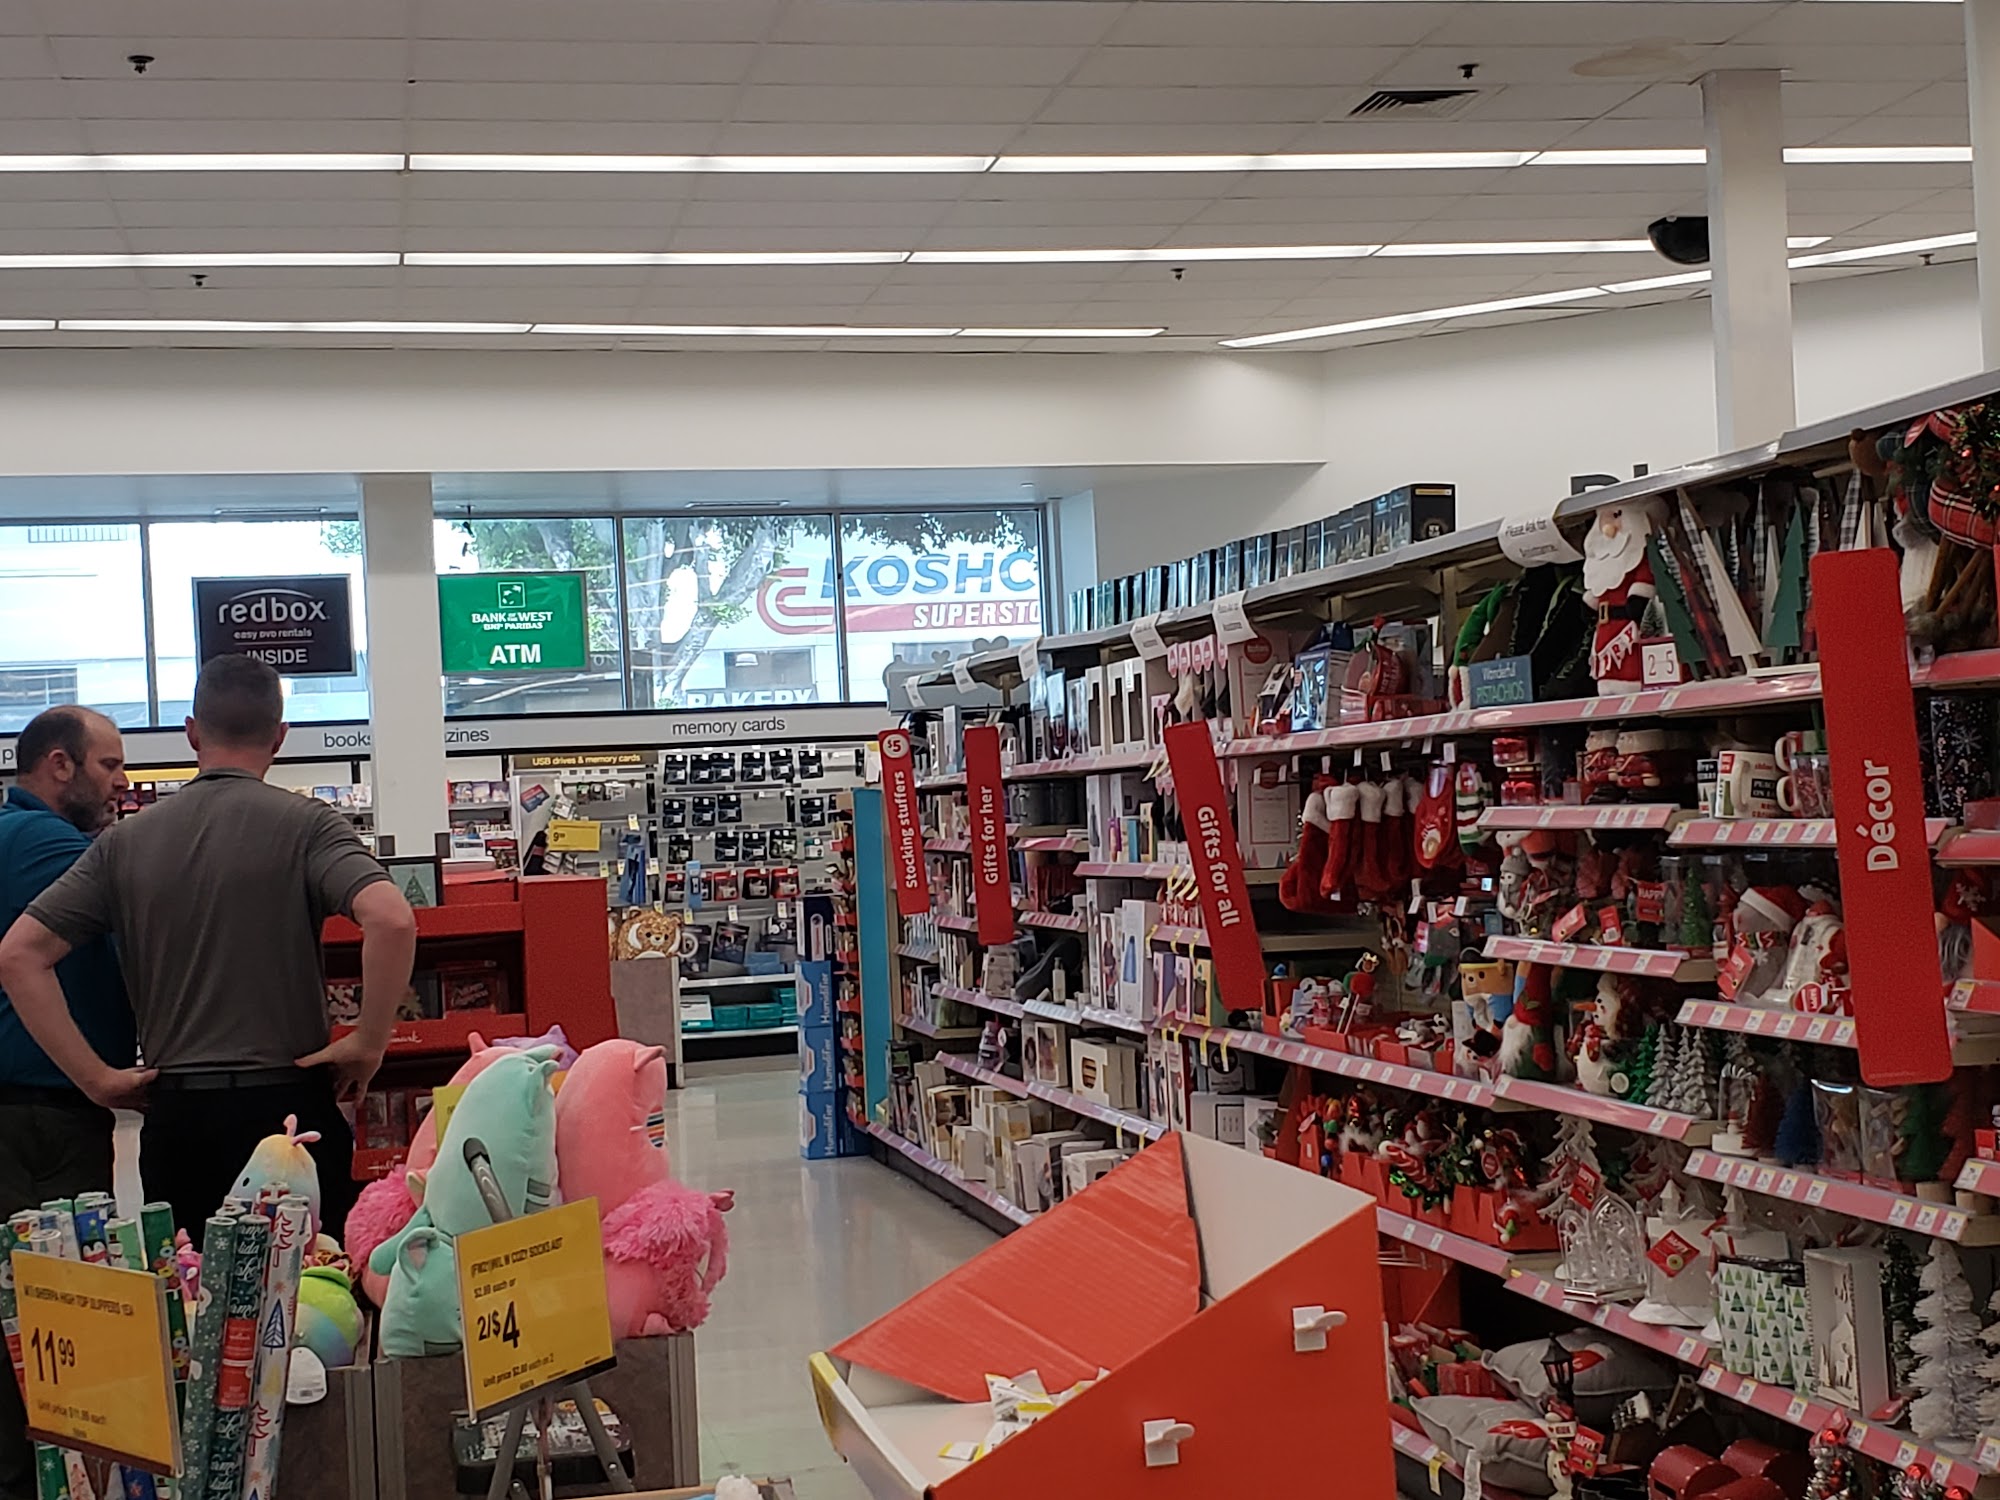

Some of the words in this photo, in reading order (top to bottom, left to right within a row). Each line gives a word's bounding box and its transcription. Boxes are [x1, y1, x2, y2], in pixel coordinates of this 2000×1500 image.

[218, 597, 326, 624] redbox
[471, 613, 507, 624] BANK
[517, 612, 553, 622] WEST
[233, 631, 258, 640] easy
[278, 628, 312, 638] rentals
[489, 643, 541, 664] ATM
[672, 721, 737, 736] memory
[742, 716, 785, 732] cards
[532, 757, 551, 765] USB
[577, 756, 584, 764] &
[585, 756, 617, 765] memory
[618, 754, 641, 762] cards
[887, 738, 902, 752] $5
[894, 770, 910, 825] stuffers
[978, 785, 994, 815] her
[1856, 759, 1899, 871] Décor
[979, 819, 995, 842] for
[1197, 806, 1221, 859] Gifts
[900, 826, 918, 888] Stocking
[980, 843, 999, 885] Gifts
[1209, 860, 1229, 894] for
[1216, 898, 1240, 927] all
[820, 973, 830, 1024] Humidifier
[822, 1038, 833, 1090] Humidifier
[823, 1104, 835, 1156] Humidifier
